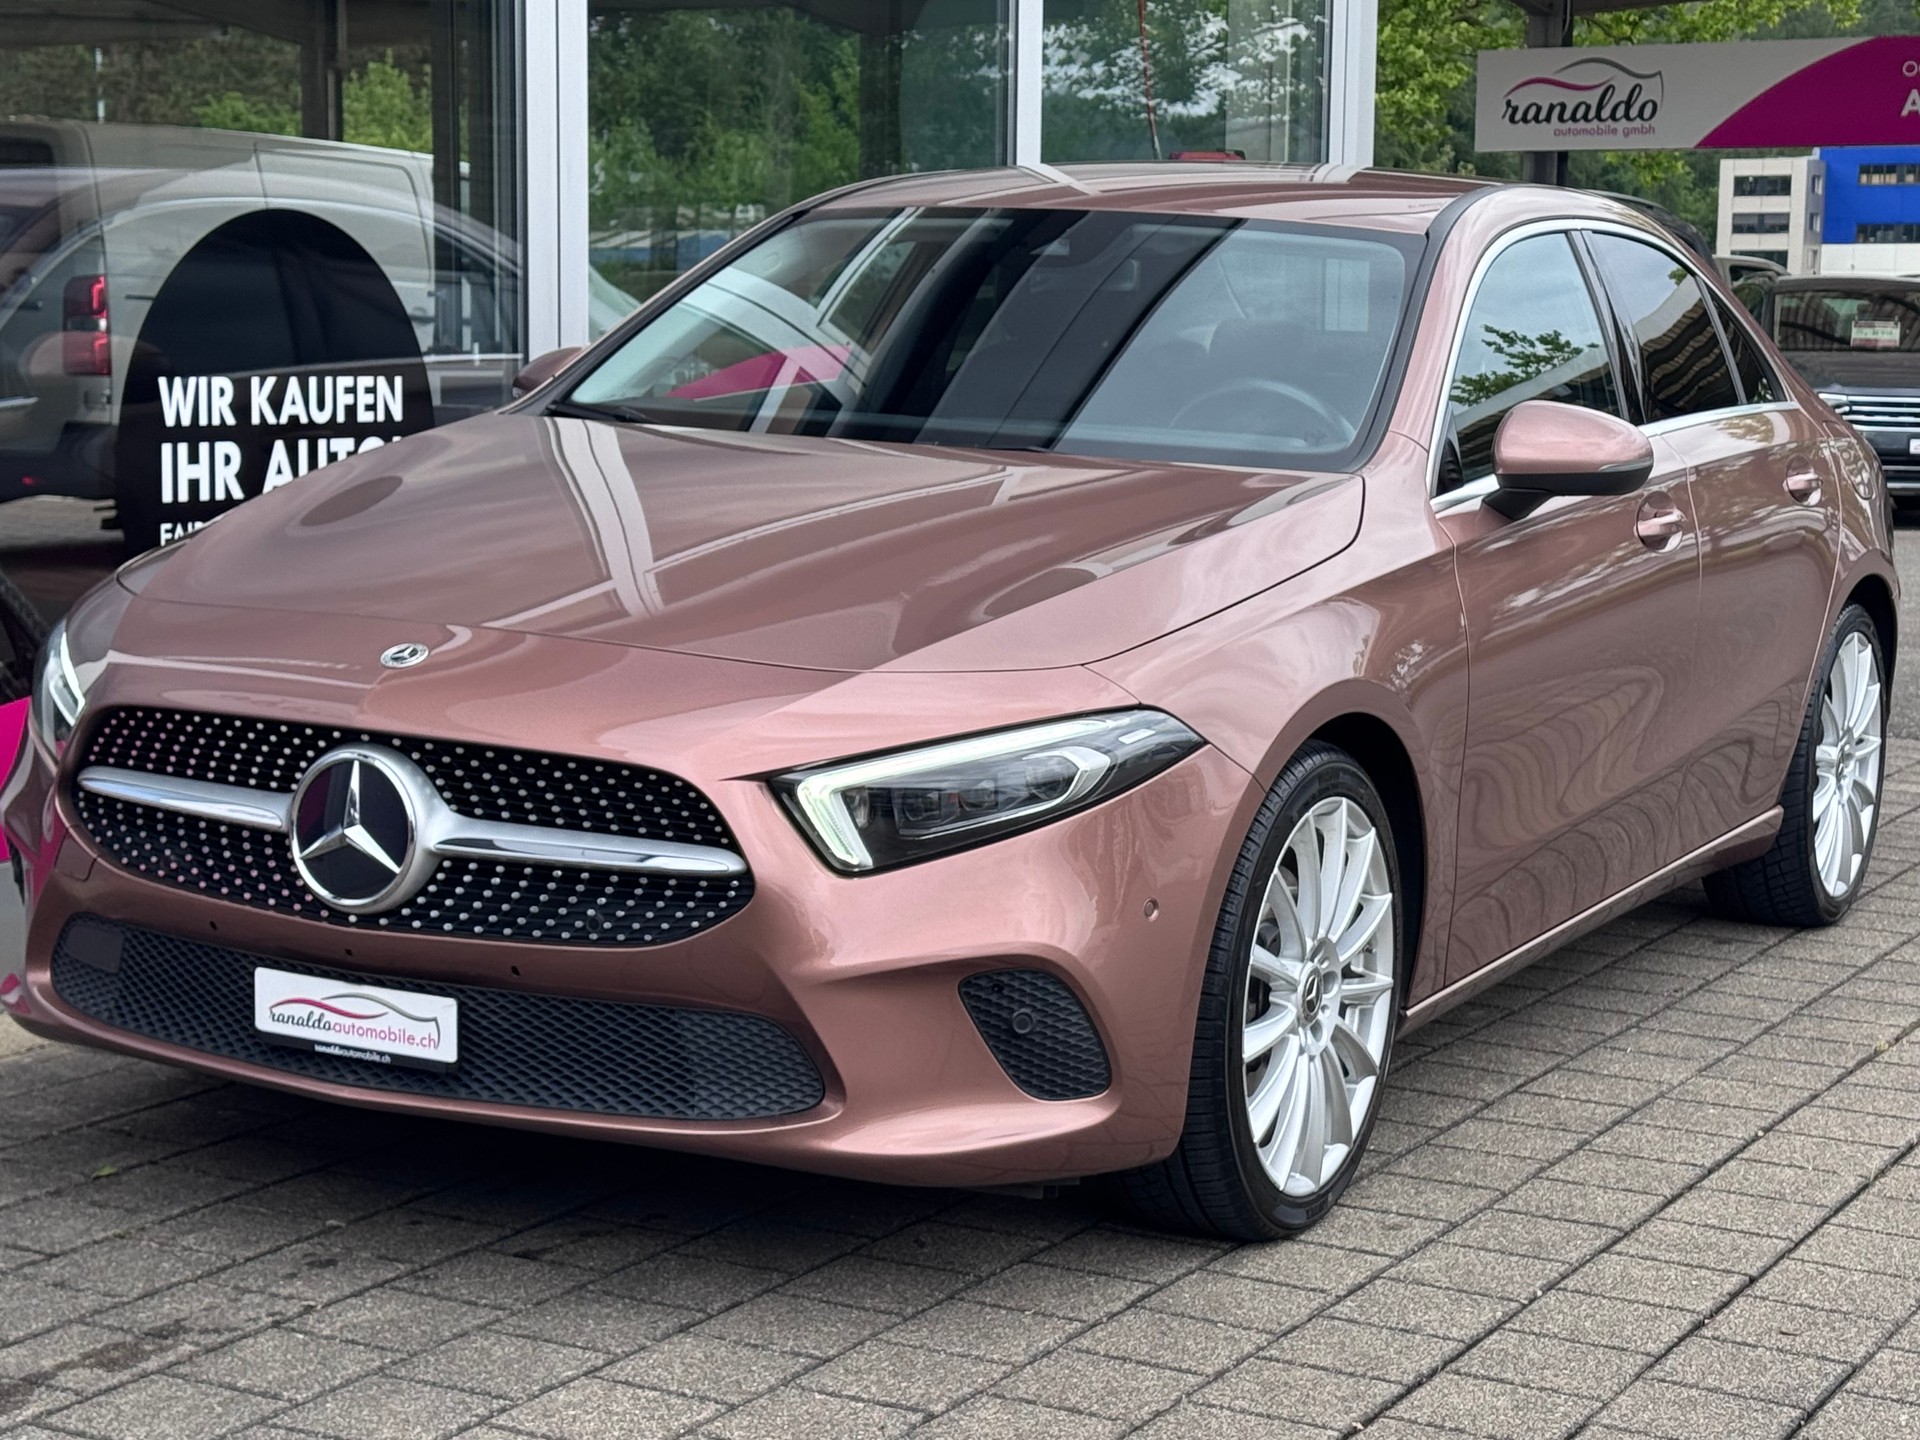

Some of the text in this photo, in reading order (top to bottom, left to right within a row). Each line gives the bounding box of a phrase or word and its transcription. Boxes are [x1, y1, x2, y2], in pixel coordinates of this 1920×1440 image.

[1501, 83, 1658, 124] ranaldo
[1553, 123, 1655, 139] automobile gmbh
[157, 375, 403, 427] WIR KAUFEN
[161, 441, 245, 504] IHR
